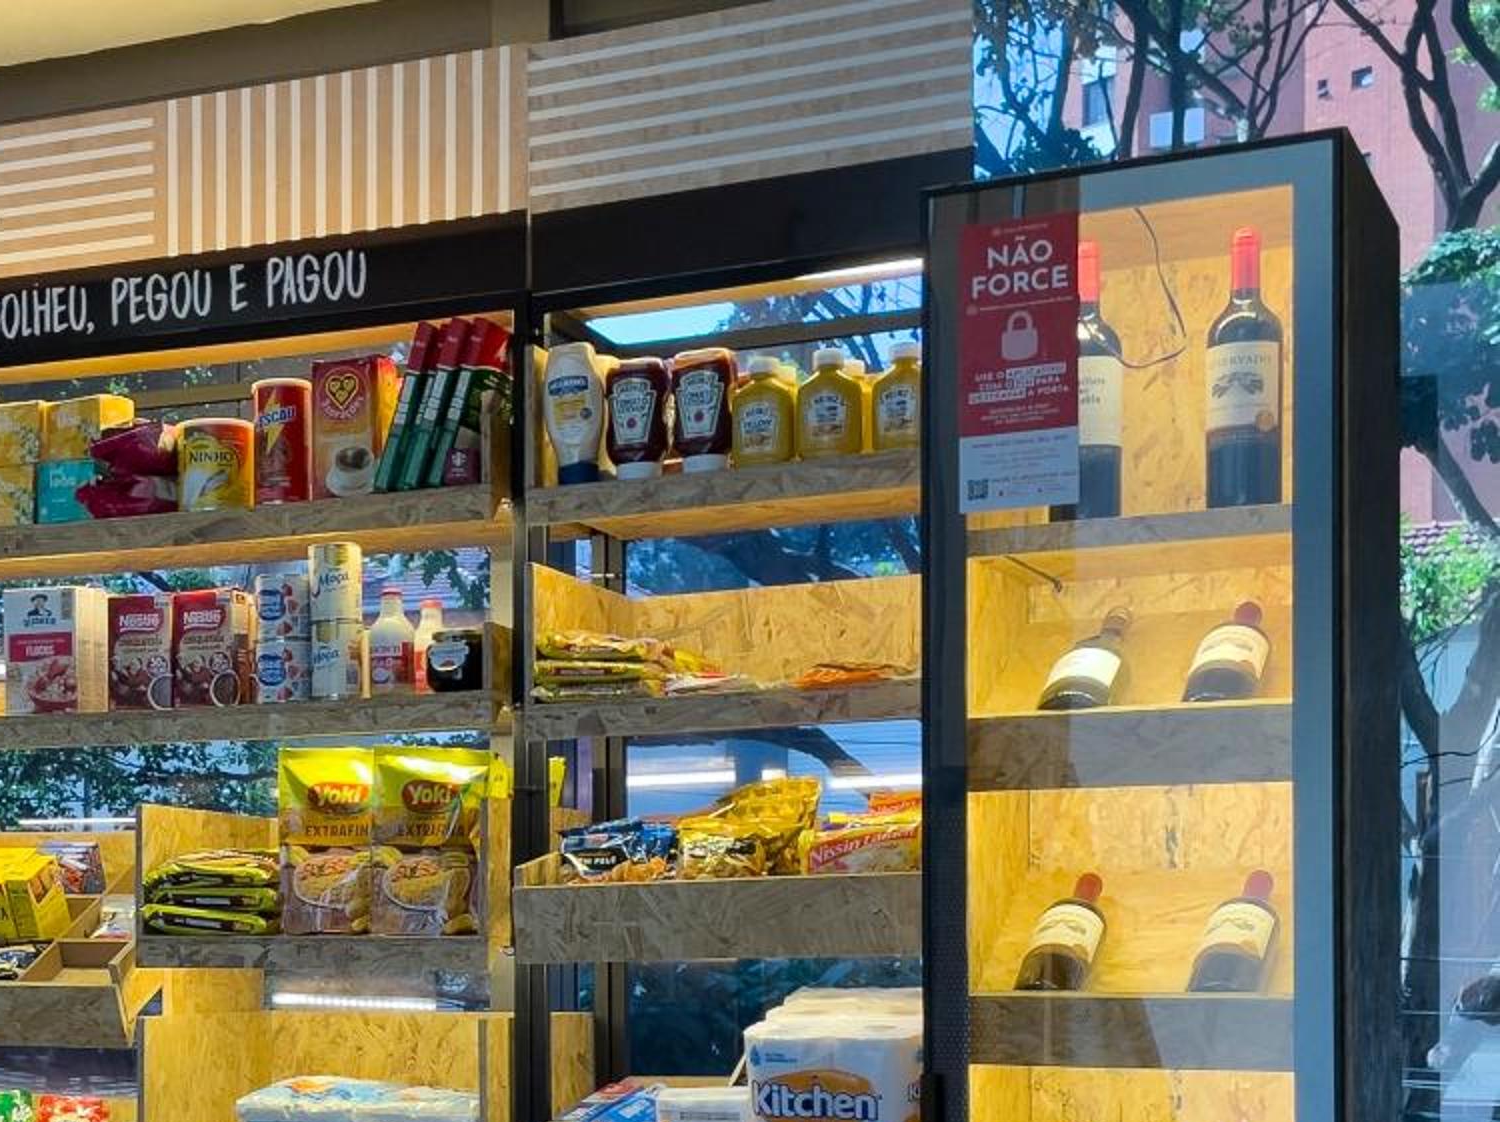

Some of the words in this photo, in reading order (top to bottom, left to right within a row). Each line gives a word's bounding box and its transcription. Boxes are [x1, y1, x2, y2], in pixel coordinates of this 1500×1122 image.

[986, 236, 1053, 269] NÃO
[111, 272, 212, 326] PEGOU
[230, 264, 248, 311] E
[267, 249, 367, 306] PAGOU
[971, 265, 1069, 299] FORCE
[188, 451, 233, 465] NINHO
[316, 783, 361, 805] Yoki
[411, 783, 451, 805] Yoki
[305, 824, 369, 838] EXTRAFIN
[810, 838, 861, 864] Nissin
[752, 1080, 879, 1121] Kitchen
